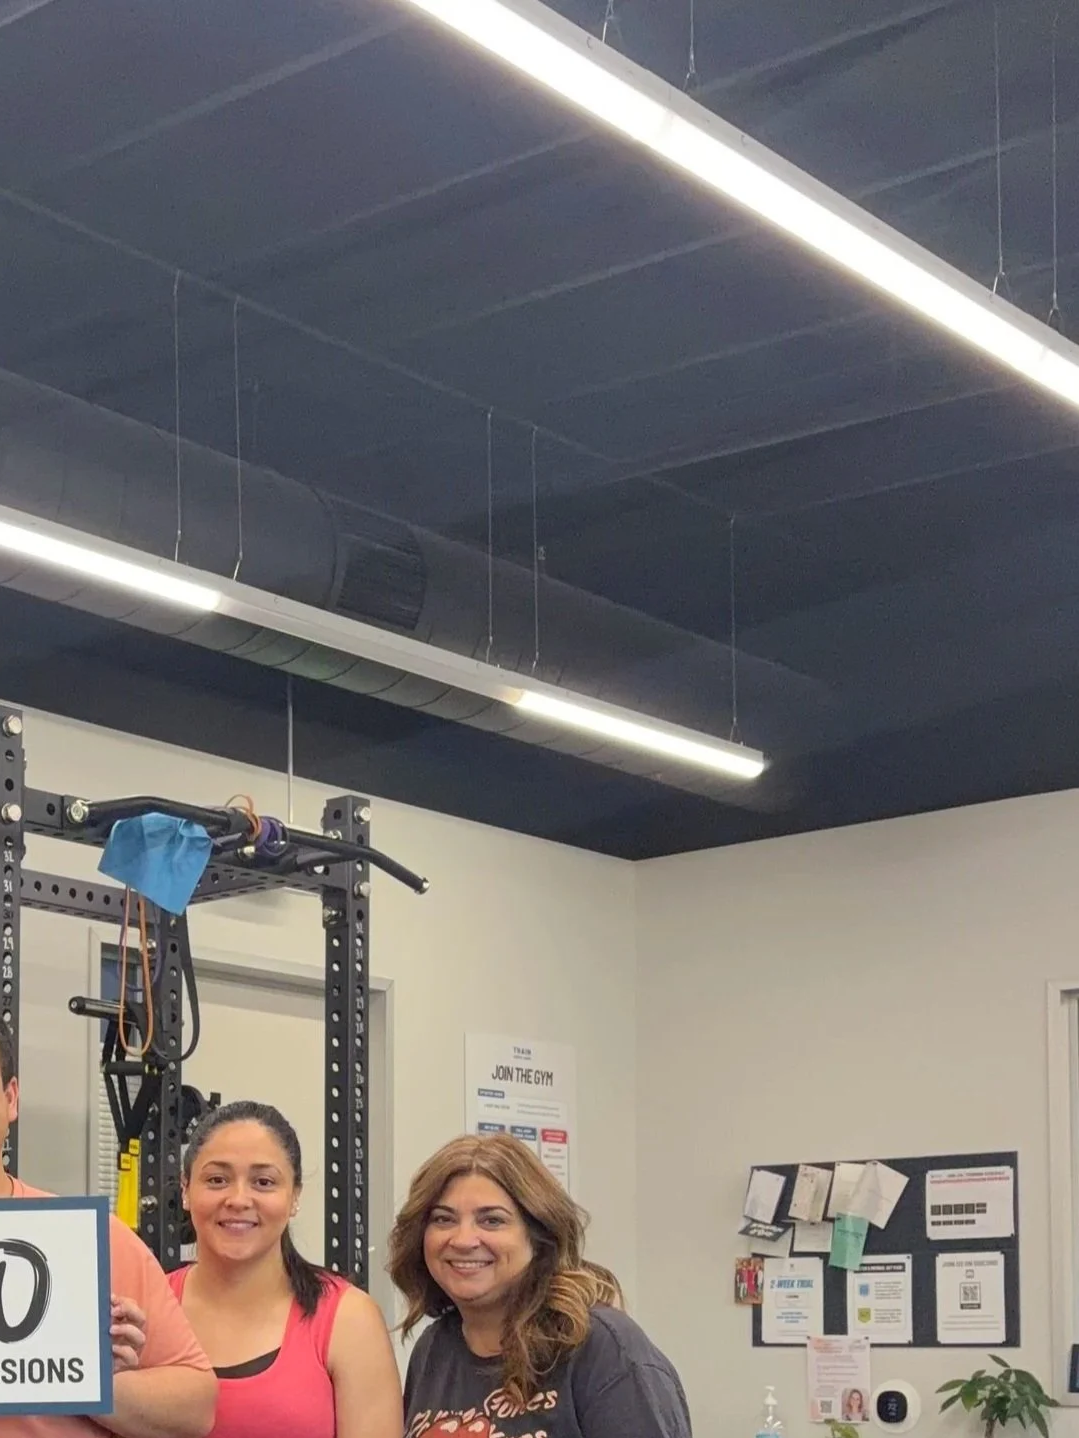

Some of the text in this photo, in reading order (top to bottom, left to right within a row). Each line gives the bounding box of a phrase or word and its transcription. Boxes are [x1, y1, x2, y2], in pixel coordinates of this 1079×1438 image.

[491, 1064, 554, 1086] JOIN THE GYM
